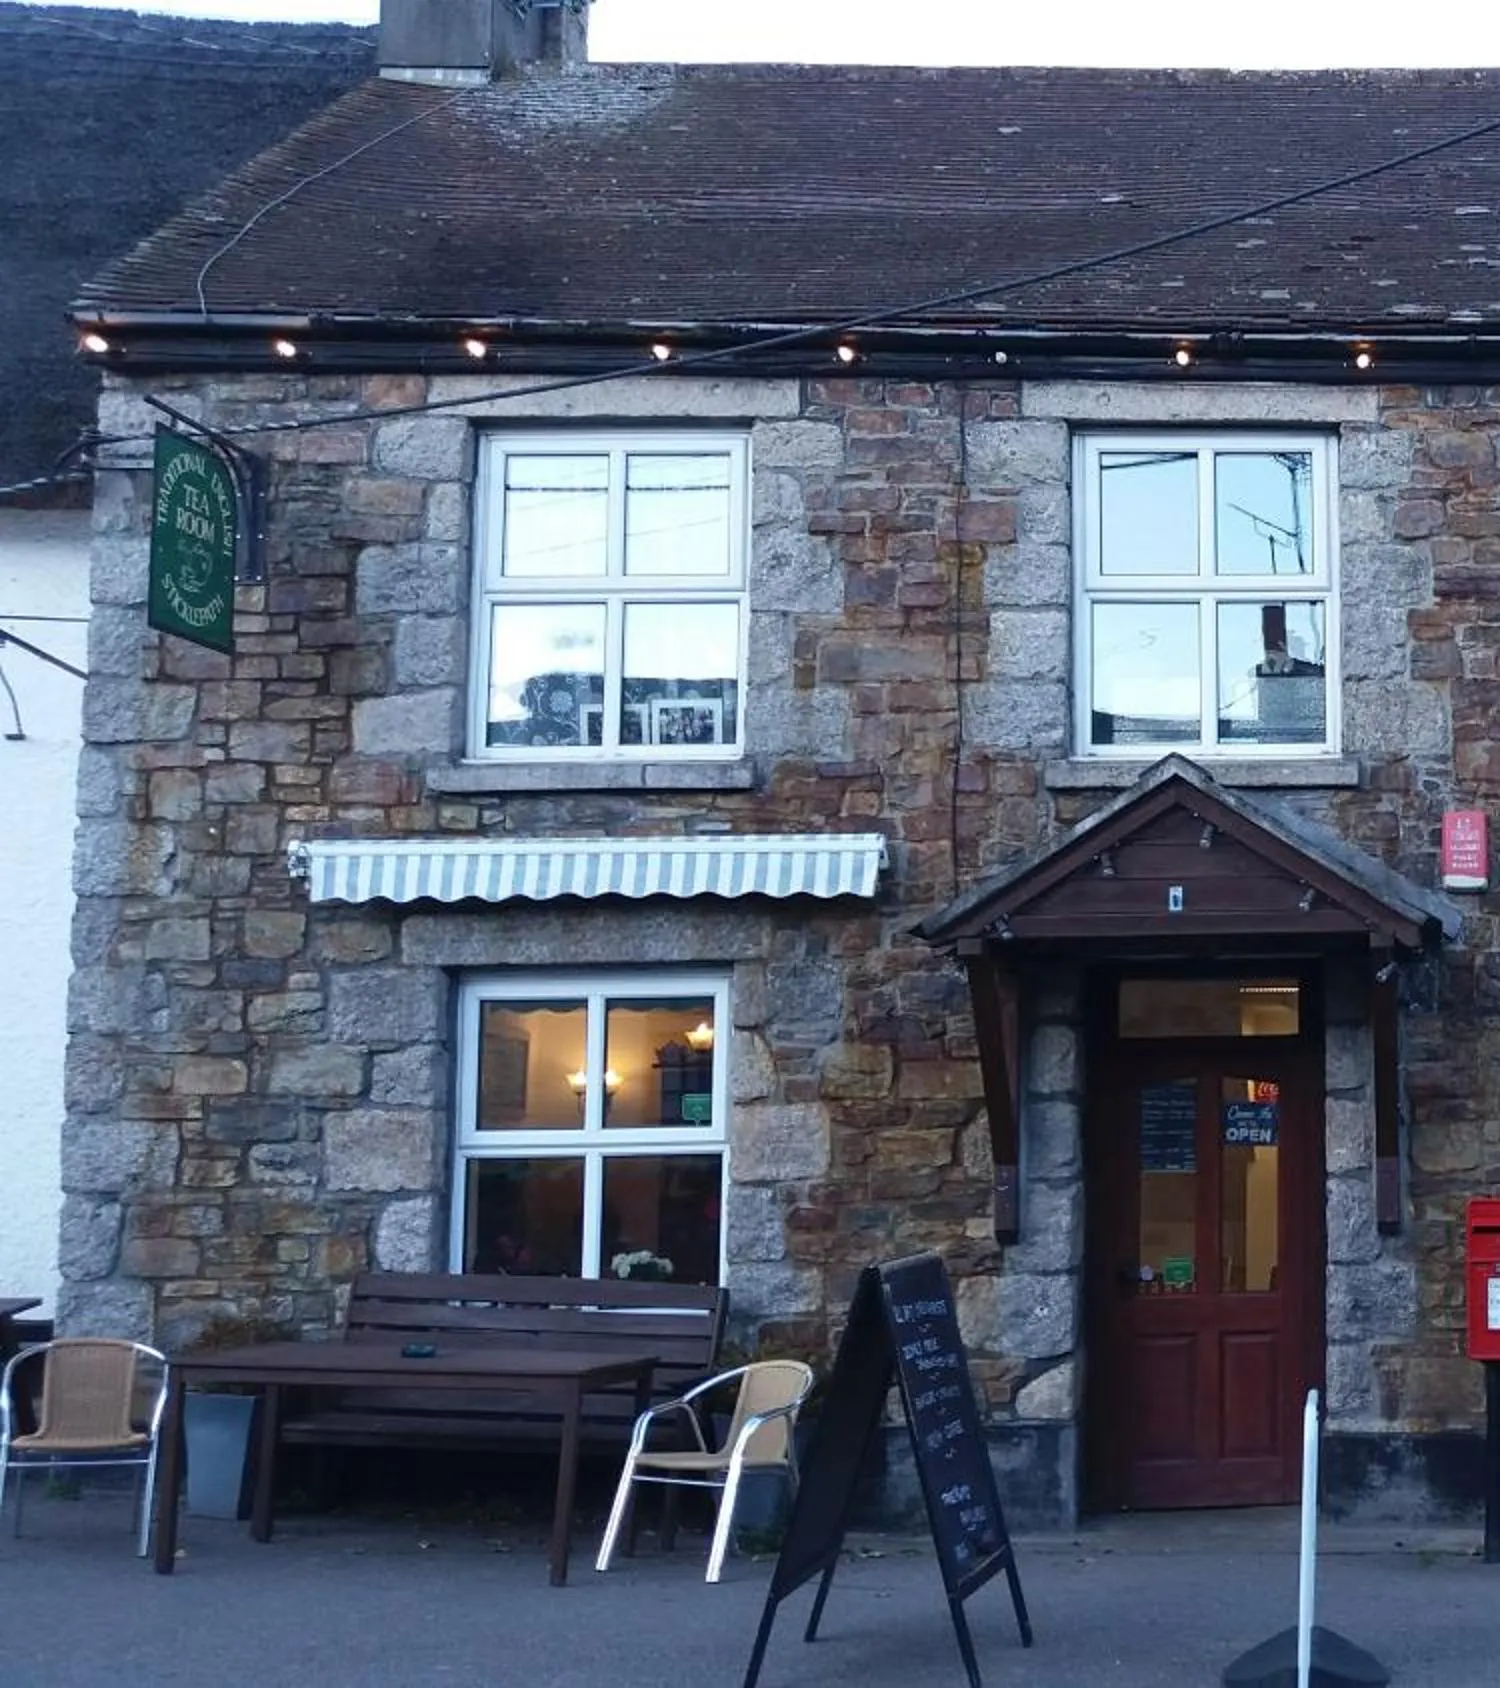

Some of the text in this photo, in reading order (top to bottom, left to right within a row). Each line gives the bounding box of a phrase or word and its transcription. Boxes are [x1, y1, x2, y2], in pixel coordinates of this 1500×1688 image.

[183, 484, 210, 517] TEA
[176, 508, 215, 544] ROOM
[161, 573, 225, 628] STICKLEPATH
[1225, 1127, 1272, 1143] OPEN
